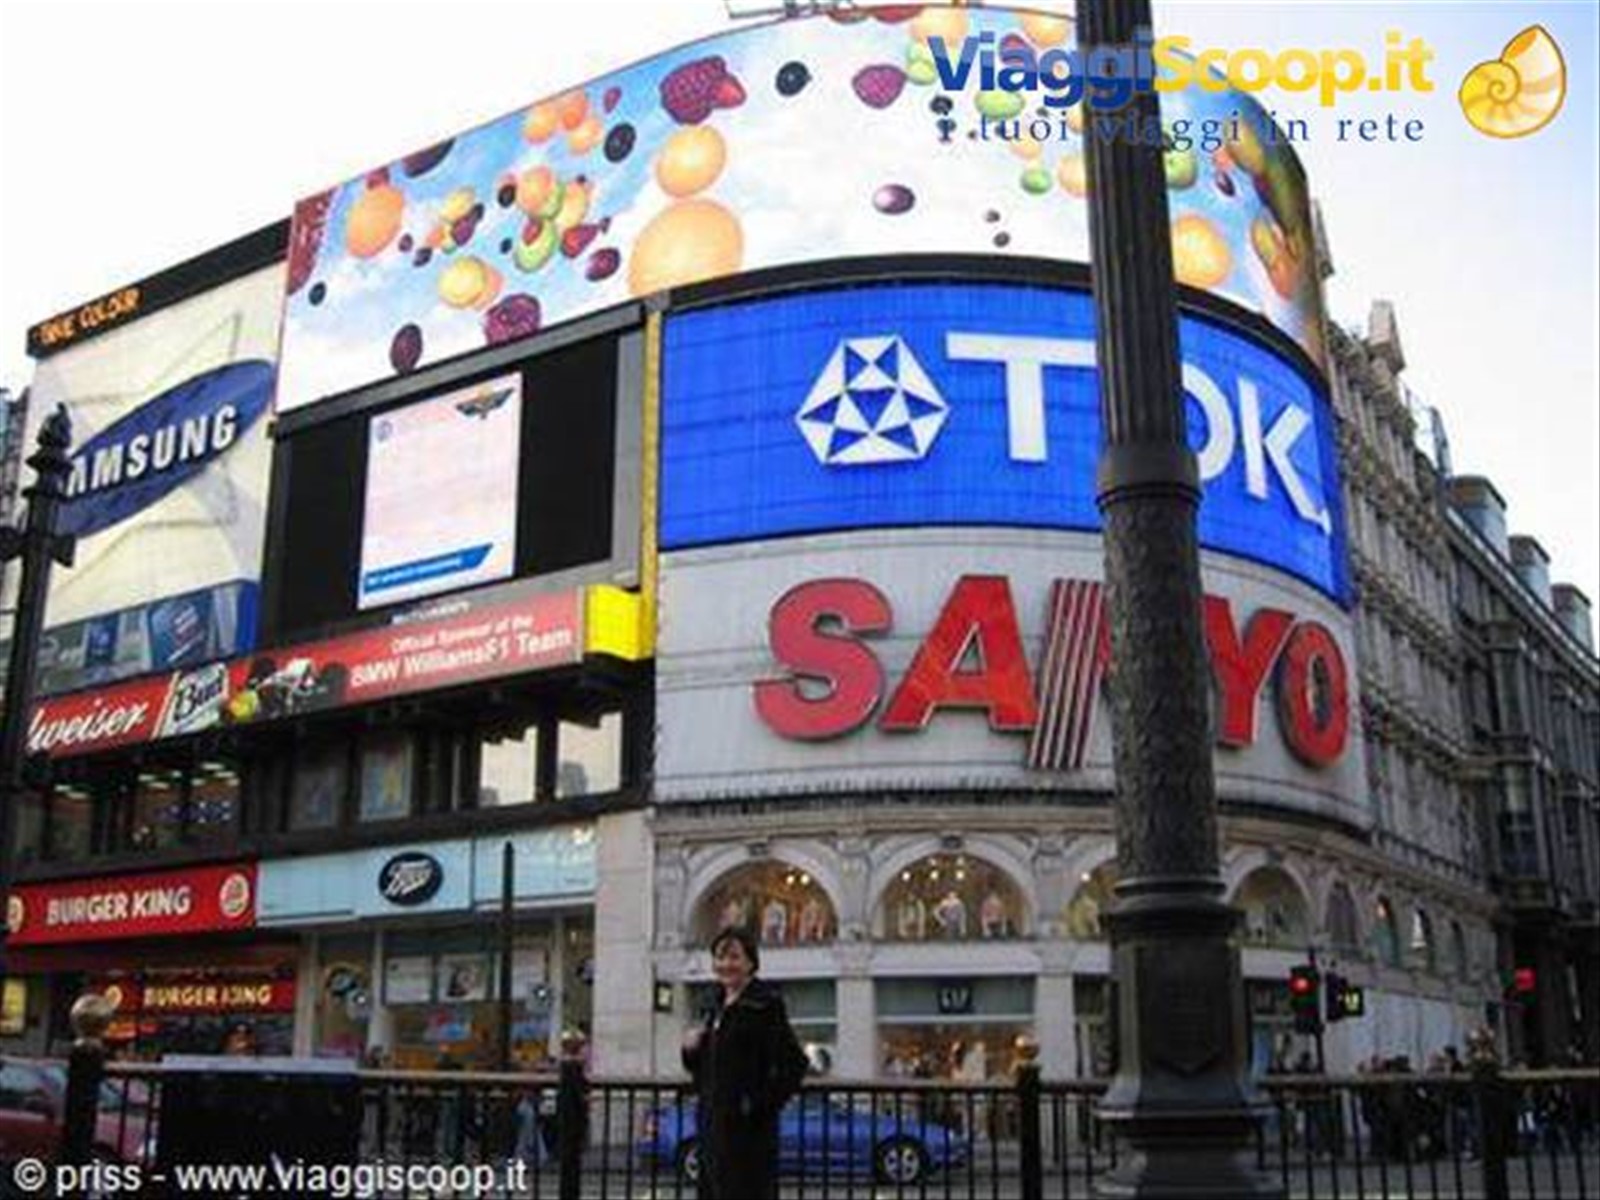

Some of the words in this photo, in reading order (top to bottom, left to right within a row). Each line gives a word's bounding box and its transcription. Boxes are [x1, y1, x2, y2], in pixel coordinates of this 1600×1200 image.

[66, 404, 237, 496] AMSUNG
[946, 332, 1332, 535] TDK
[350, 656, 400, 687] BMW
[517, 628, 573, 656] Team
[28, 697, 149, 749] weiser
[47, 892, 128, 926] BURGER
[132, 886, 191, 917] KING
[144, 985, 218, 1007] BURGER
[220, 984, 272, 1005] KING
